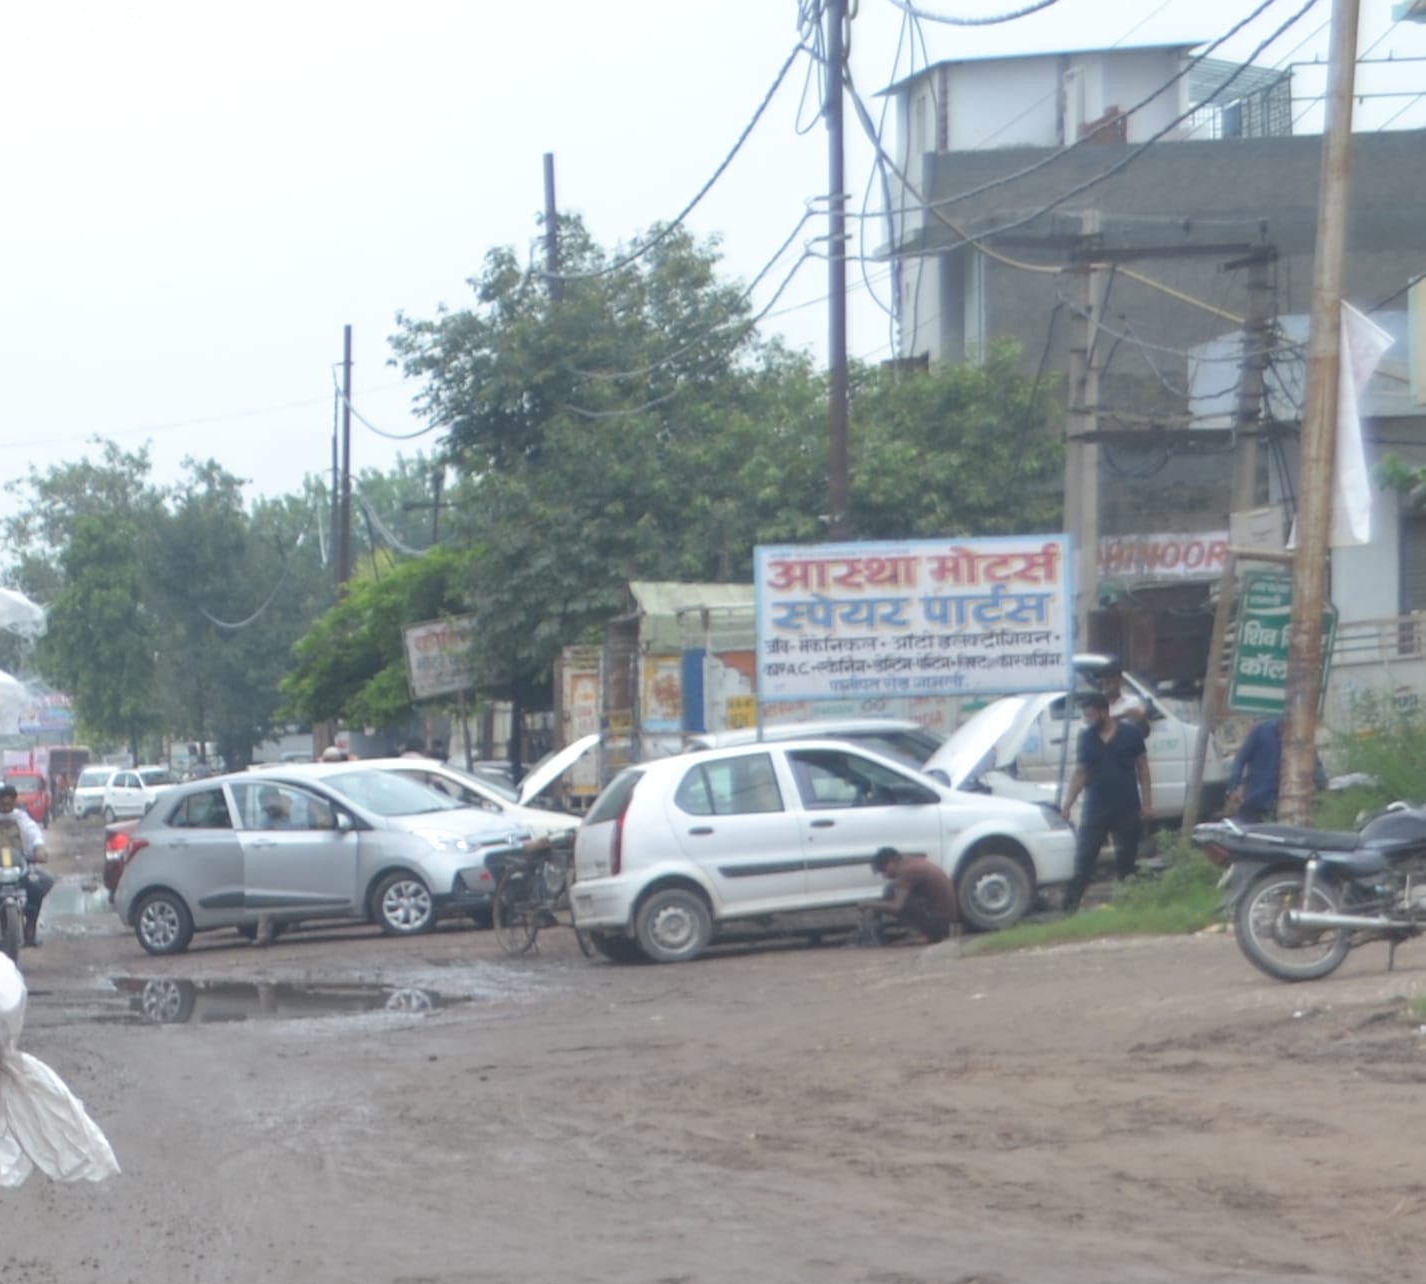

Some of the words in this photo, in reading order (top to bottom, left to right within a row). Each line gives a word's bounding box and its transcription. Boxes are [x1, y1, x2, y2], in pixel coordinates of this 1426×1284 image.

[767, 556, 919, 590] आस्था
[925, 543, 1061, 585] मोटर्स
[771, 592, 914, 632] स्पेयर
[1243, 620, 1279, 648] शिव
